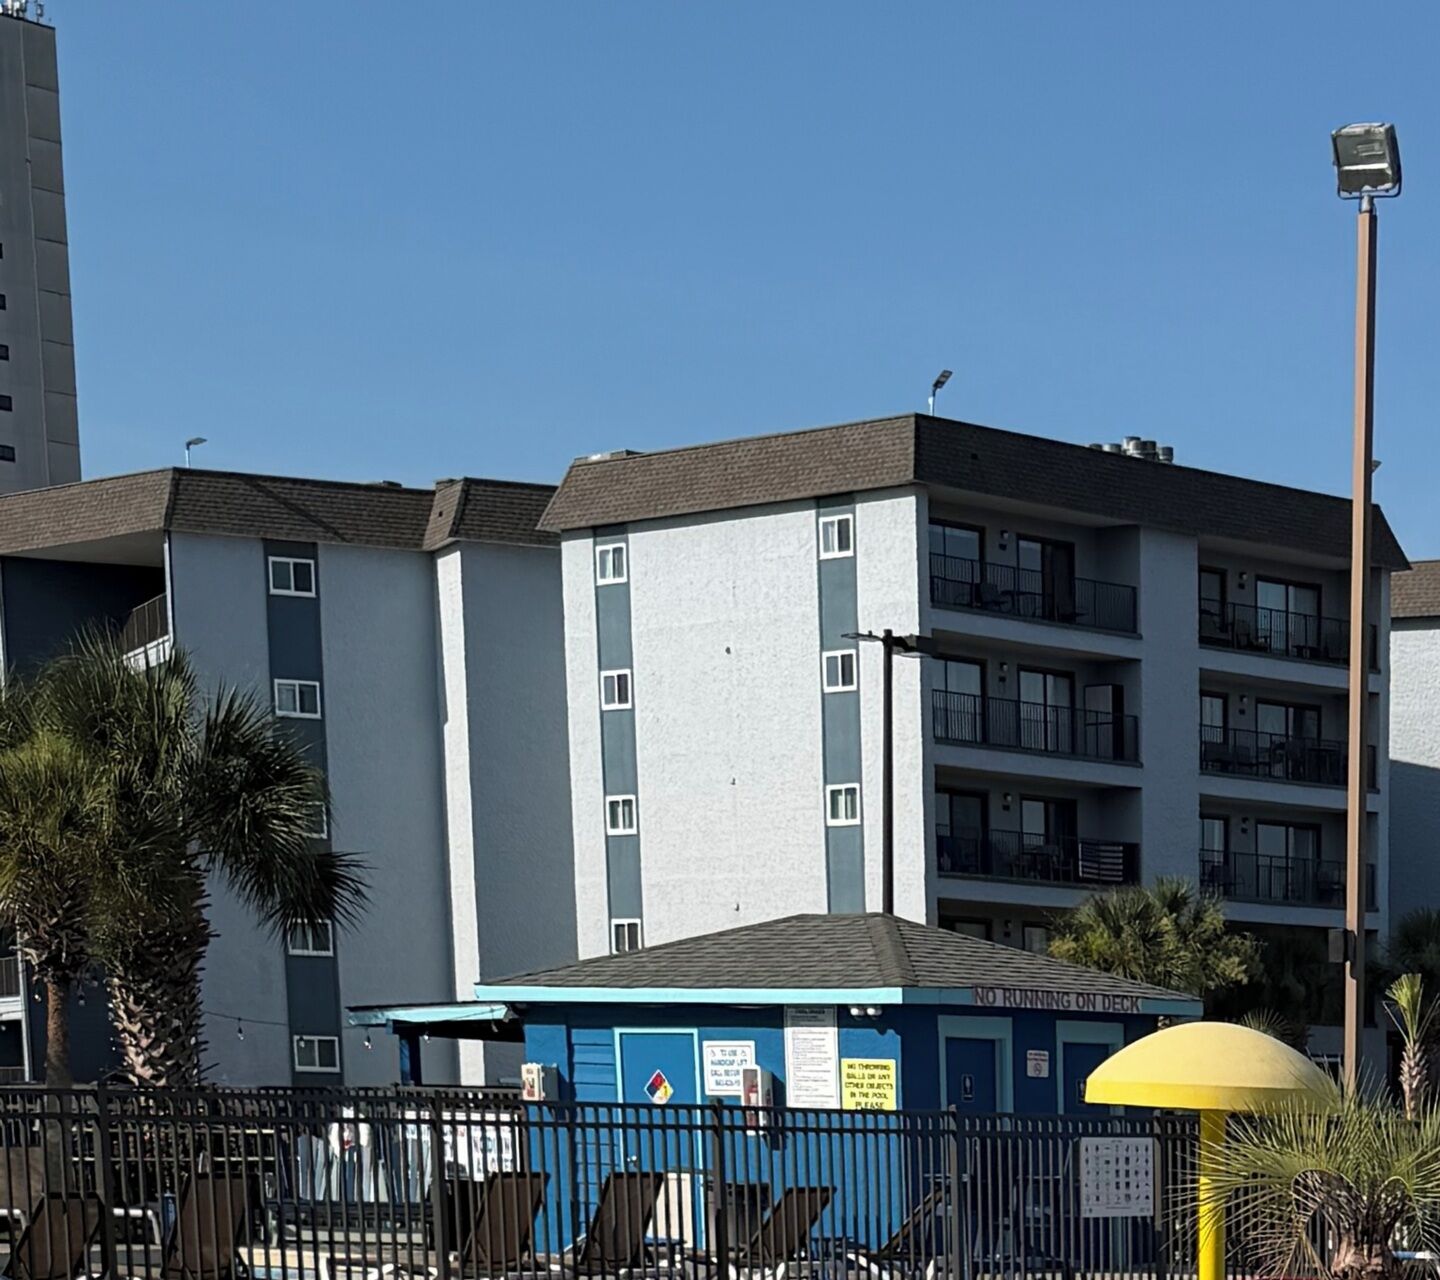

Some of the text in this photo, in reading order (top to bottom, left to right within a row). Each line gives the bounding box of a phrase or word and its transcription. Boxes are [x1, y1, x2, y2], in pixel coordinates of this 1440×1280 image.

[974, 987, 1141, 1013] NO RUNNING ON DECK
